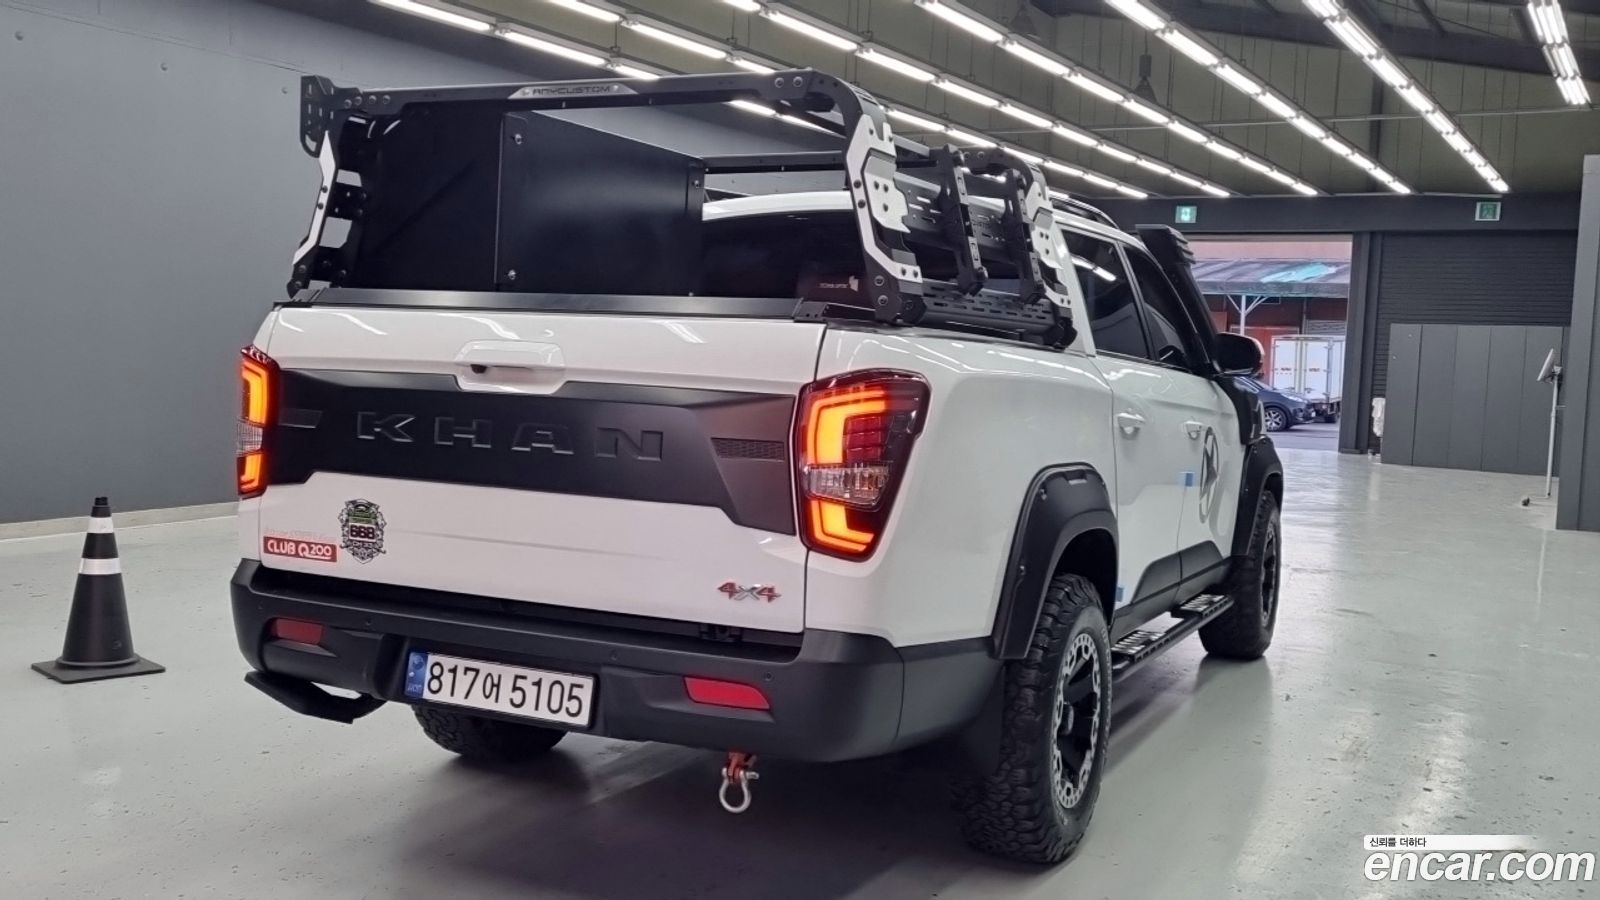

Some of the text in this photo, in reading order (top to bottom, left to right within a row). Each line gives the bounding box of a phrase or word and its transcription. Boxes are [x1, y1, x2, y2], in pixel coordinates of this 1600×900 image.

[532, 85, 611, 96] ANYCUSTOM
[356, 410, 664, 462] KHAN
[267, 539, 296, 555] CLUB
[298, 543, 333, 560] Q200
[427, 661, 585, 718] 817어 5105
